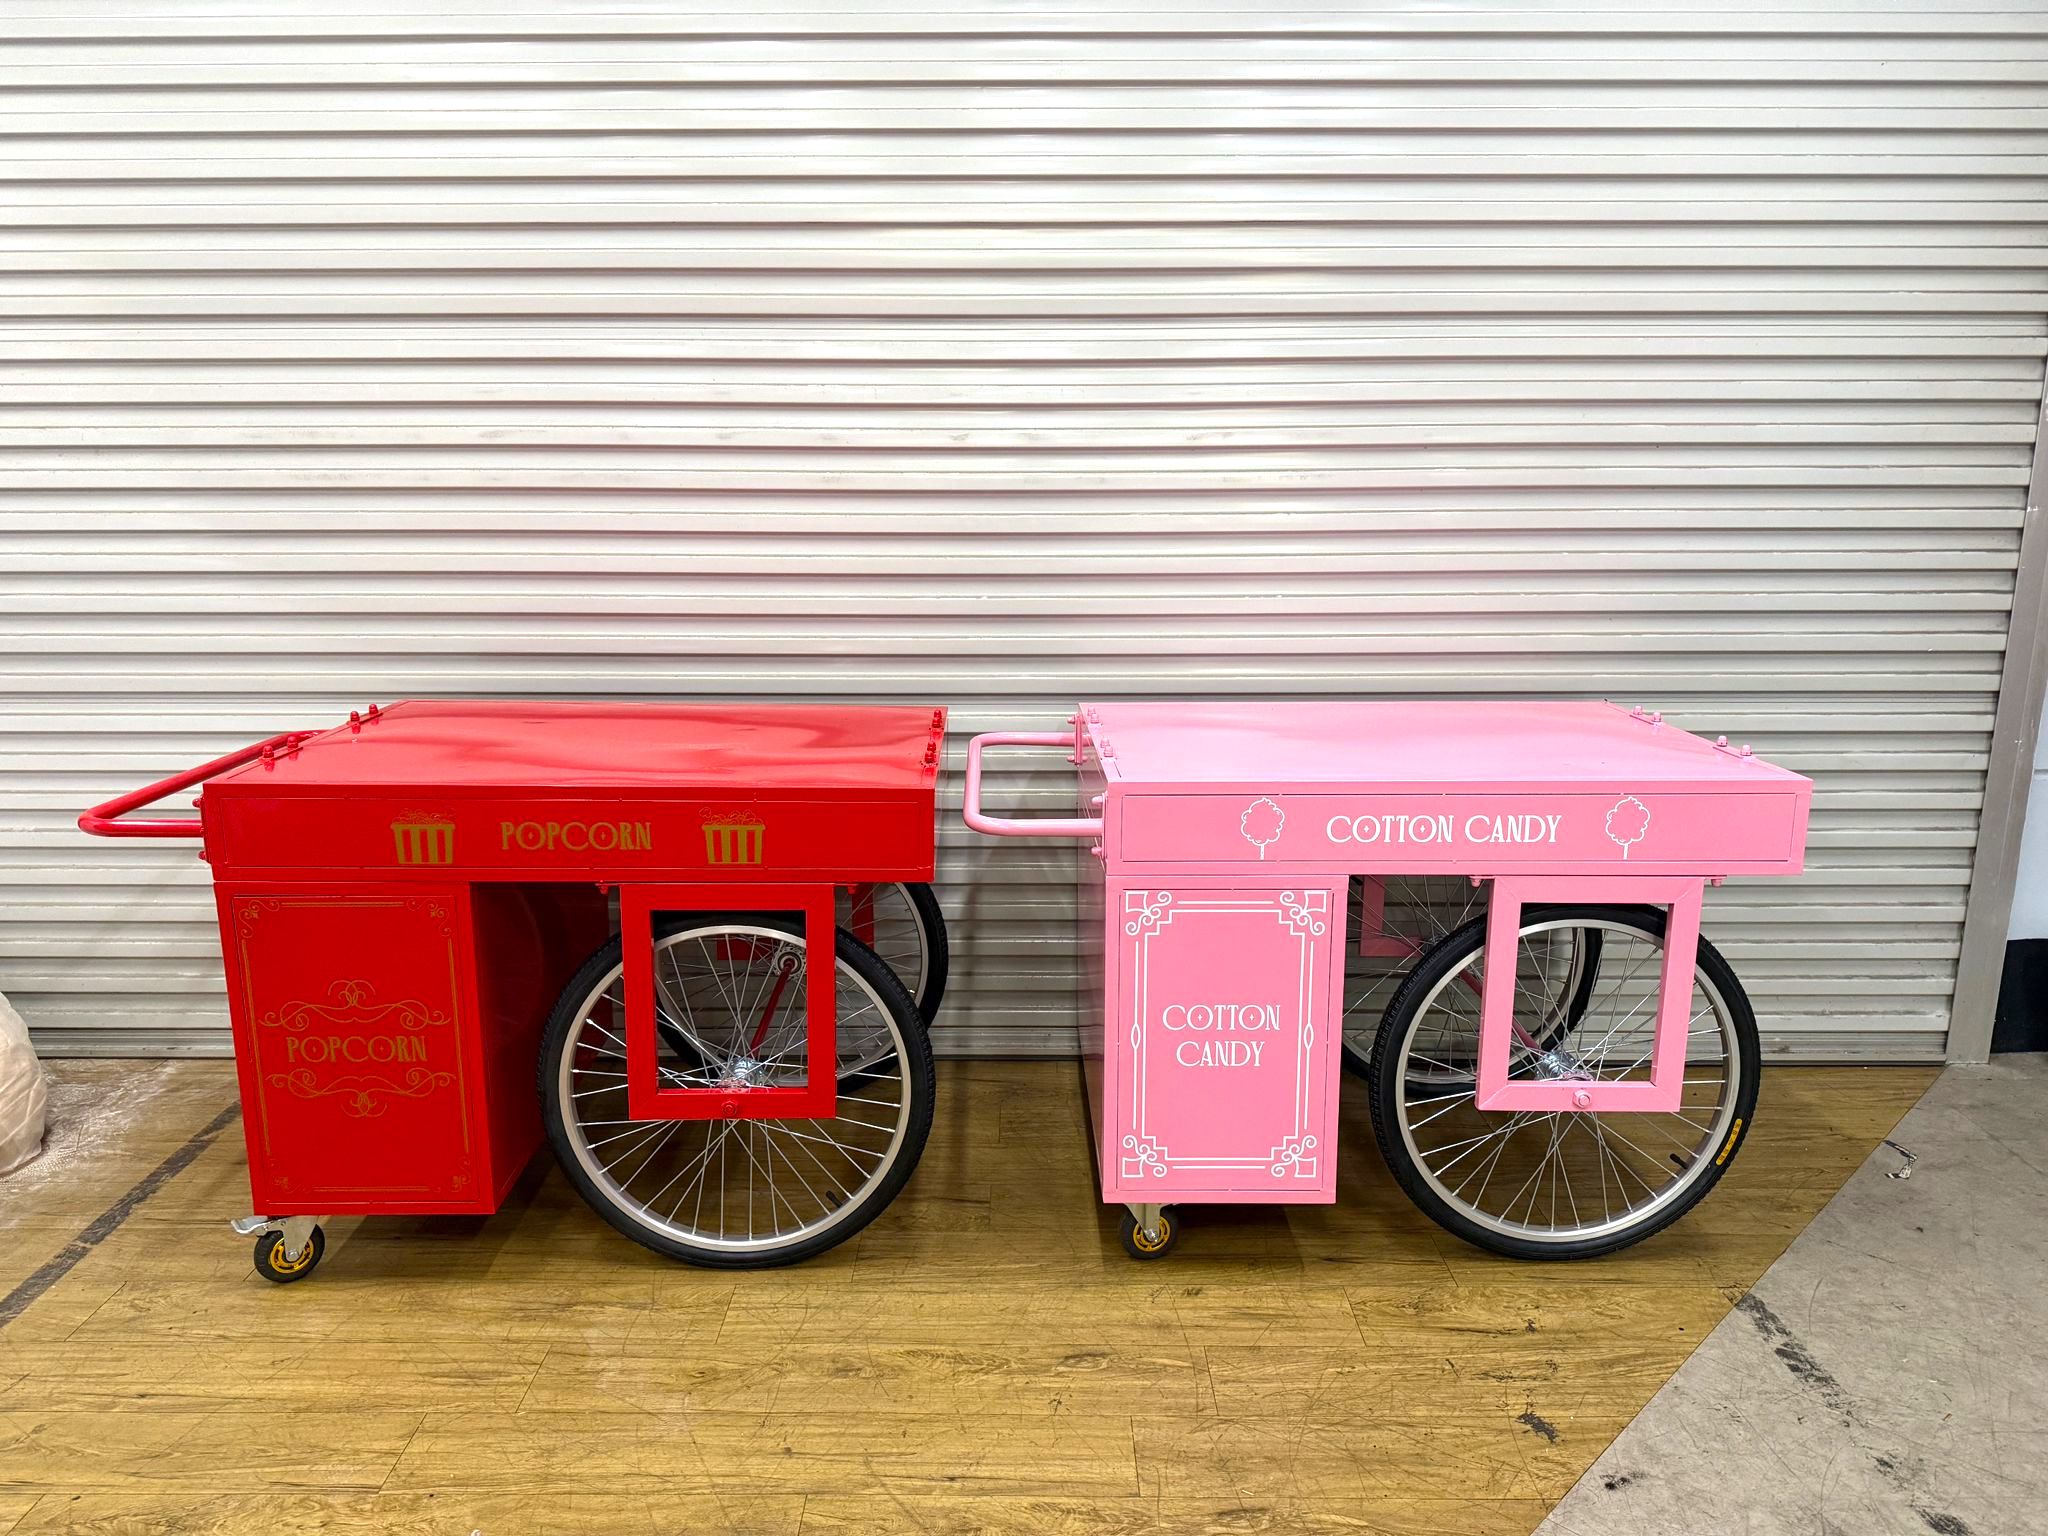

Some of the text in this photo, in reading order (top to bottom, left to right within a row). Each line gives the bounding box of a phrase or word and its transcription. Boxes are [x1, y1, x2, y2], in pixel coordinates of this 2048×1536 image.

[500, 821, 653, 851] POPCORN
[1326, 814, 1563, 843] COTTON CANDY
[1162, 1004, 1281, 1031] COTTON
[285, 1035, 427, 1063] POPCORN
[1176, 1040, 1265, 1067] CANDY
